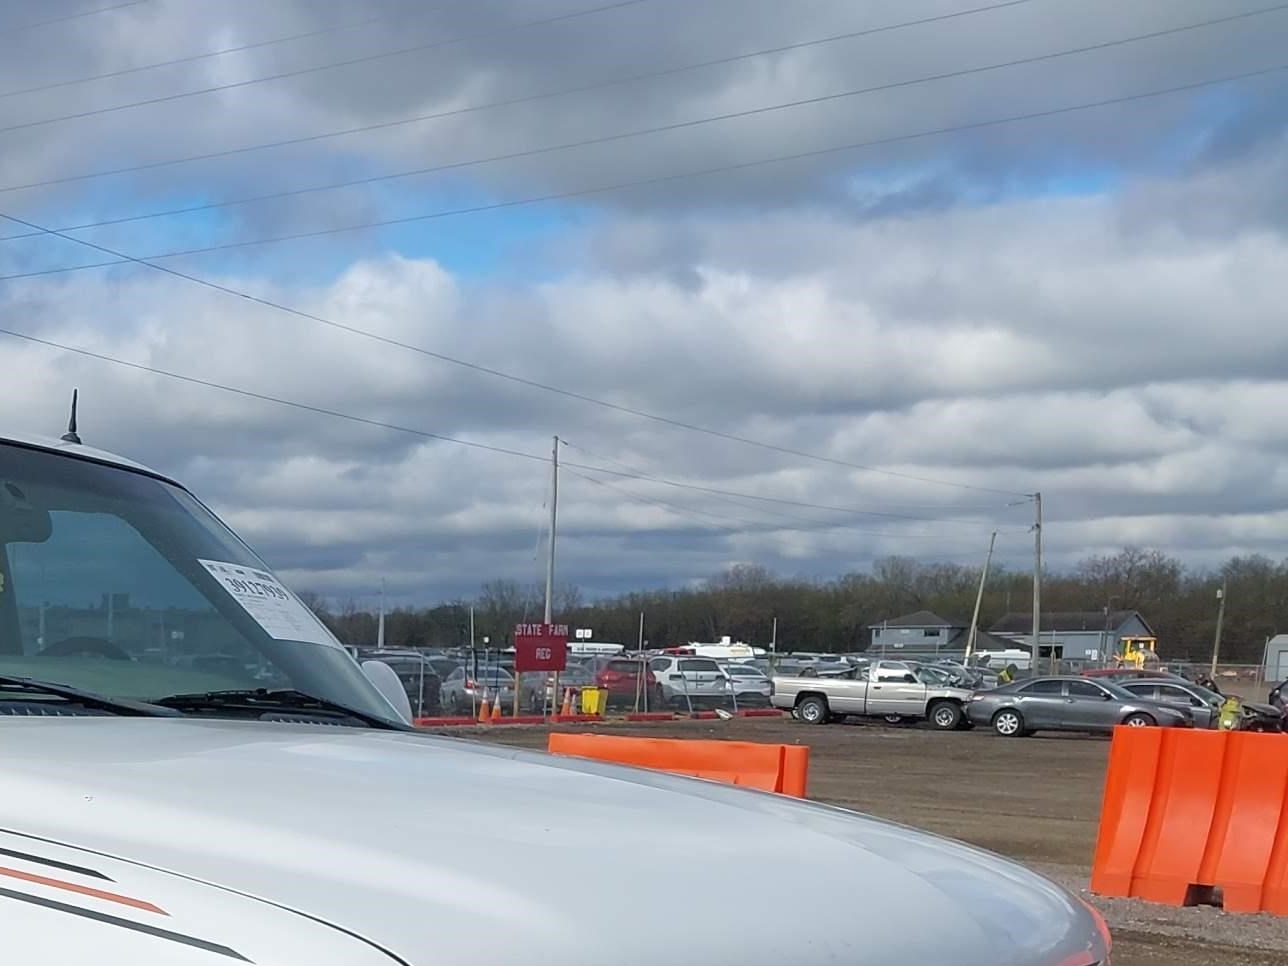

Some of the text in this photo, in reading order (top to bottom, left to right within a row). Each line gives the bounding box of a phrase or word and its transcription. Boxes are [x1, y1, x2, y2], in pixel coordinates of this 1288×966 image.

[225, 577, 290, 601] 39127939
[515, 623, 542, 636] STATE
[549, 624, 569, 636] FARM
[535, 647, 551, 660] REG
